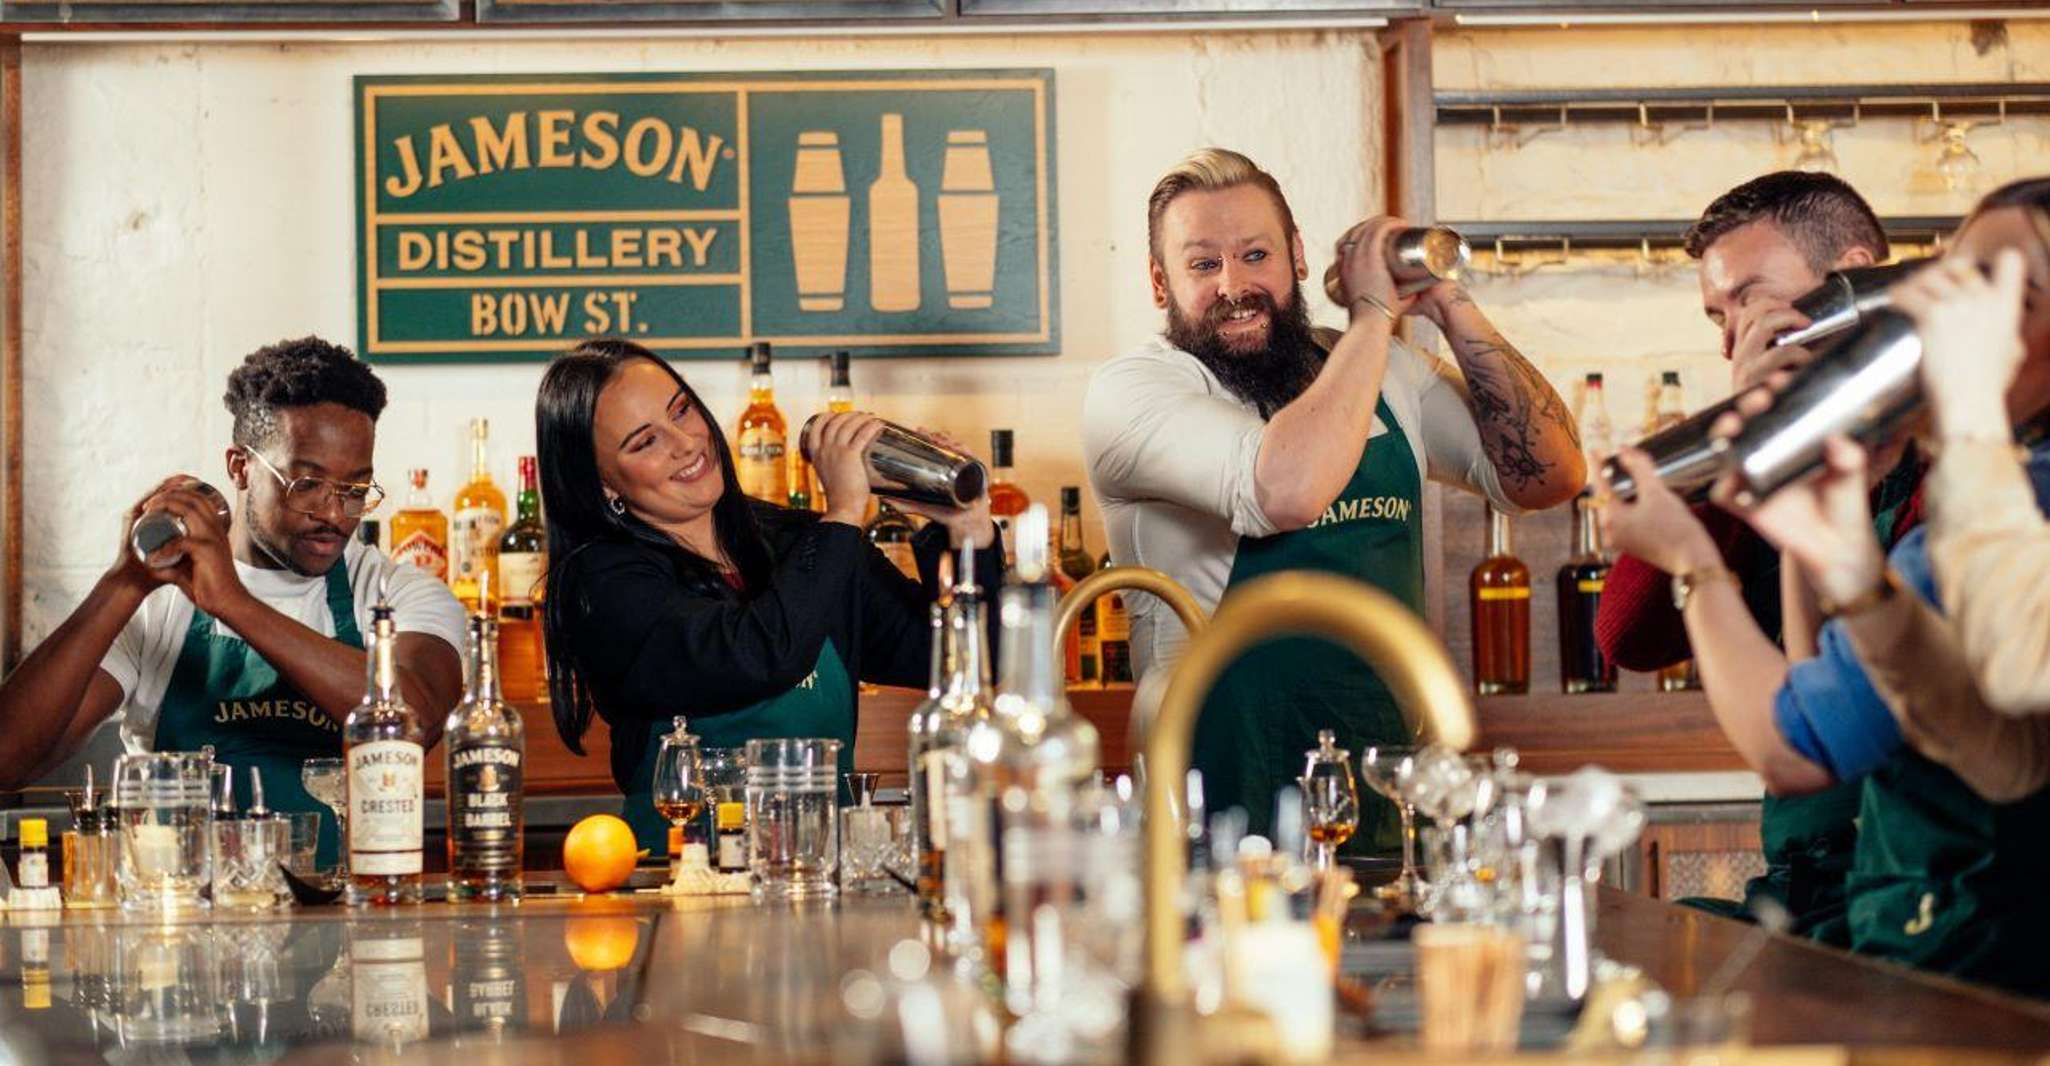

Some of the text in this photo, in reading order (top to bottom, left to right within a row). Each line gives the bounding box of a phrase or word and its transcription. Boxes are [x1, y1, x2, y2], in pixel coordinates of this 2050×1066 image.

[385, 110, 724, 197] JAMESON
[398, 228, 718, 271] DISTILLERY
[471, 291, 648, 336] BOW ST.
[355, 750, 419, 770] JAMESON
[453, 747, 521, 770] JAMESON
[360, 799, 416, 815] CRESTED
